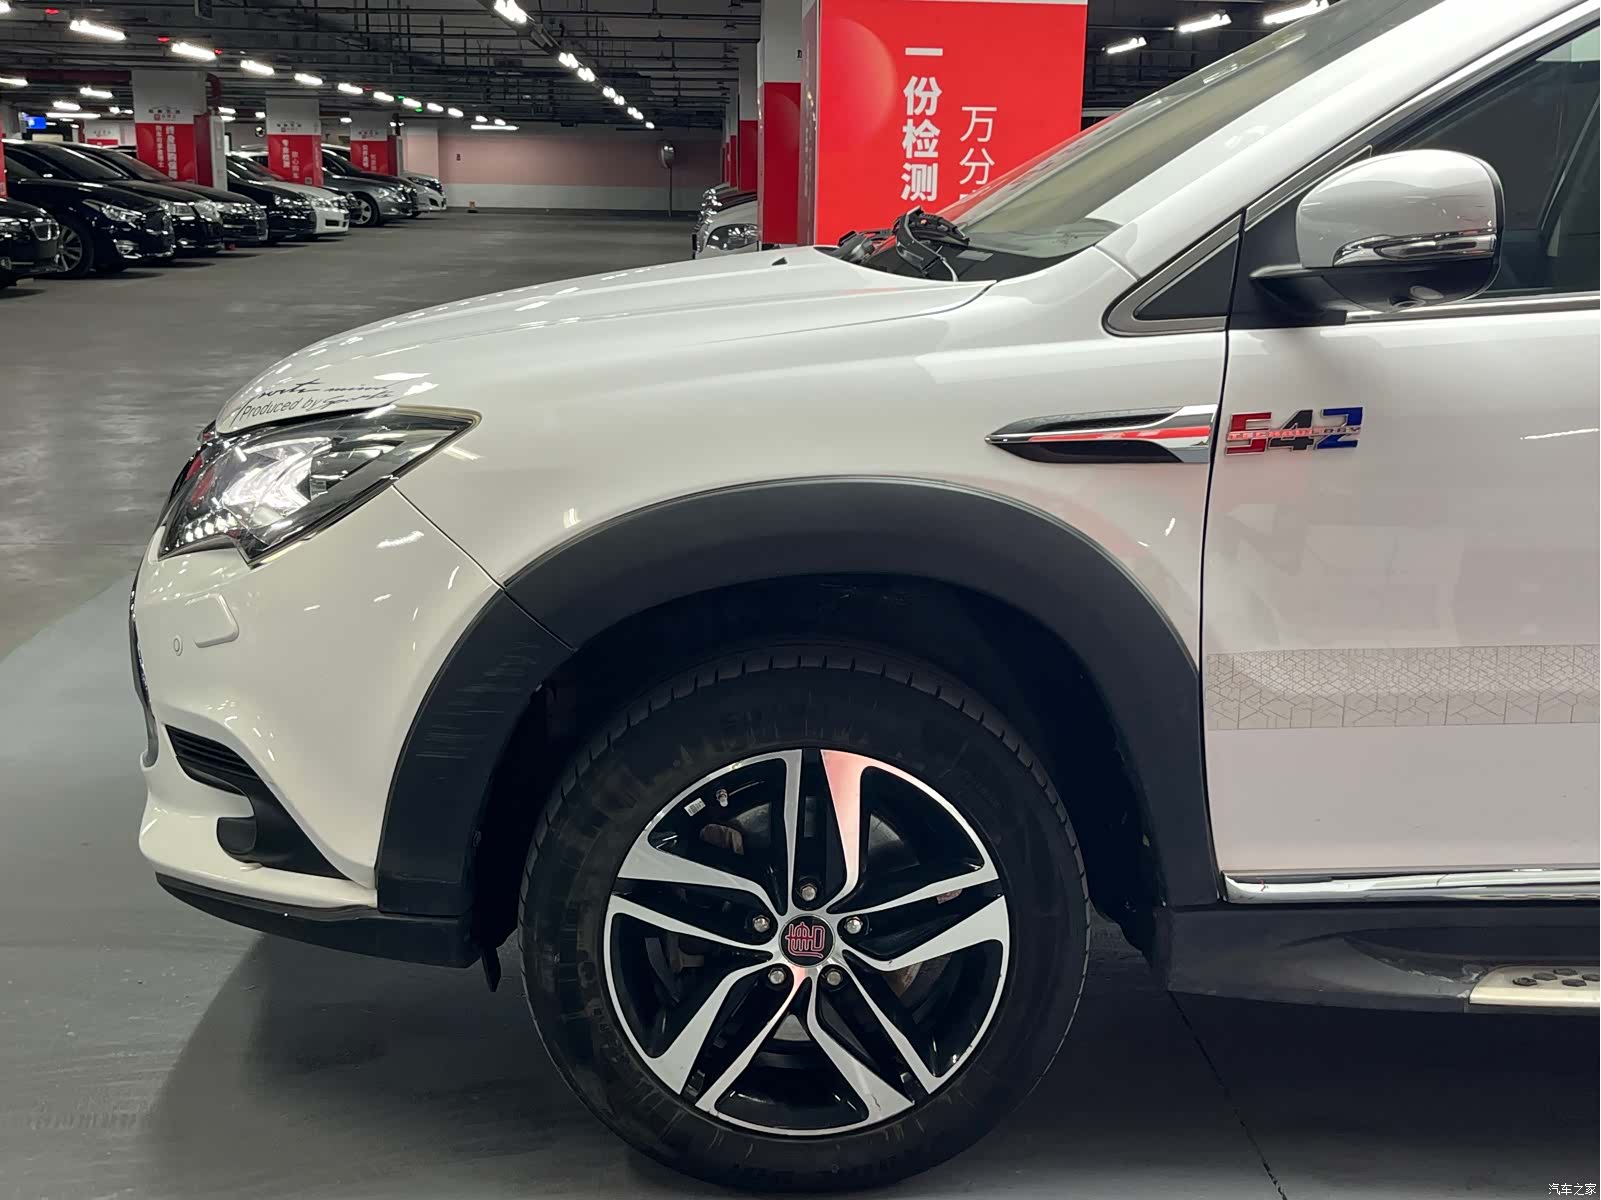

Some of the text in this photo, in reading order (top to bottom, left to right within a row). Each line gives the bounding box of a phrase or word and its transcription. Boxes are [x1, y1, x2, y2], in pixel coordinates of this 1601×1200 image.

[901, 47, 943, 202] 一份检测
[959, 106, 998, 200] 万分
[240, 397, 304, 421] Produced
[301, 397, 323, 410] by
[1225, 406, 1363, 456] 542
